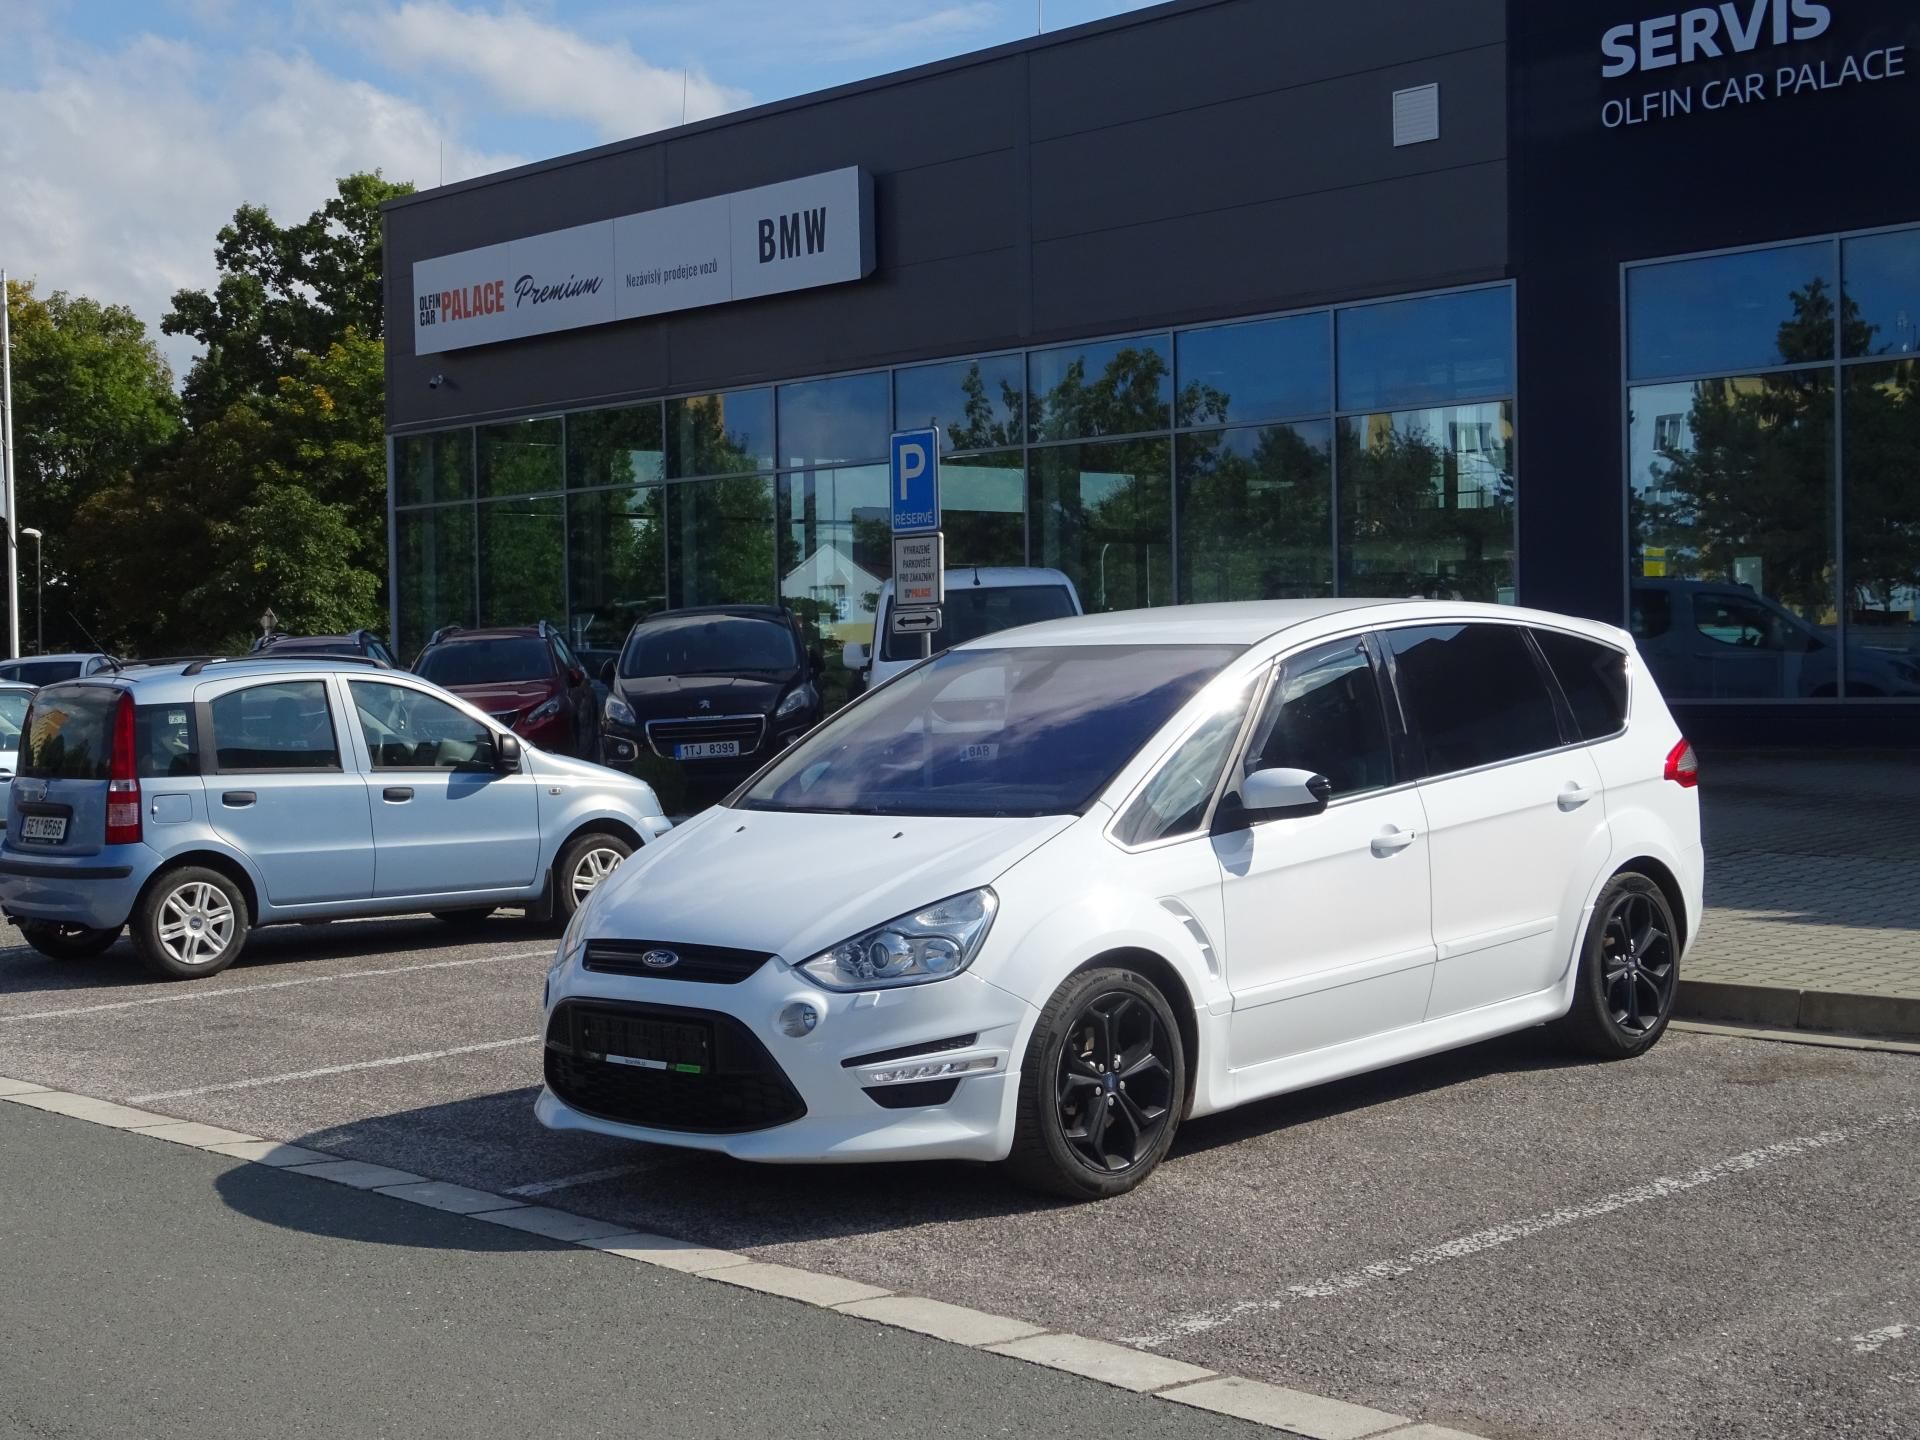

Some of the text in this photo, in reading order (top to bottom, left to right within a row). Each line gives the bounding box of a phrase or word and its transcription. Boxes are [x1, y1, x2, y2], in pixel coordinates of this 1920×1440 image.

[1601, 0, 1831, 77] SERVIS
[1601, 46, 1905, 128] OLFIN CAR PALACE
[758, 206, 826, 264] BMW
[626, 257, 718, 288] Nezávislý prodejce vozů
[419, 293, 441, 311] OLFIN
[441, 280, 505, 323] PALACE
[514, 274, 604, 308] Premium
[420, 310, 436, 326] CAR
[899, 443, 926, 500] P
[895, 508, 933, 525] RÉSERVÉ
[684, 743, 734, 756] 1TJ 8399
